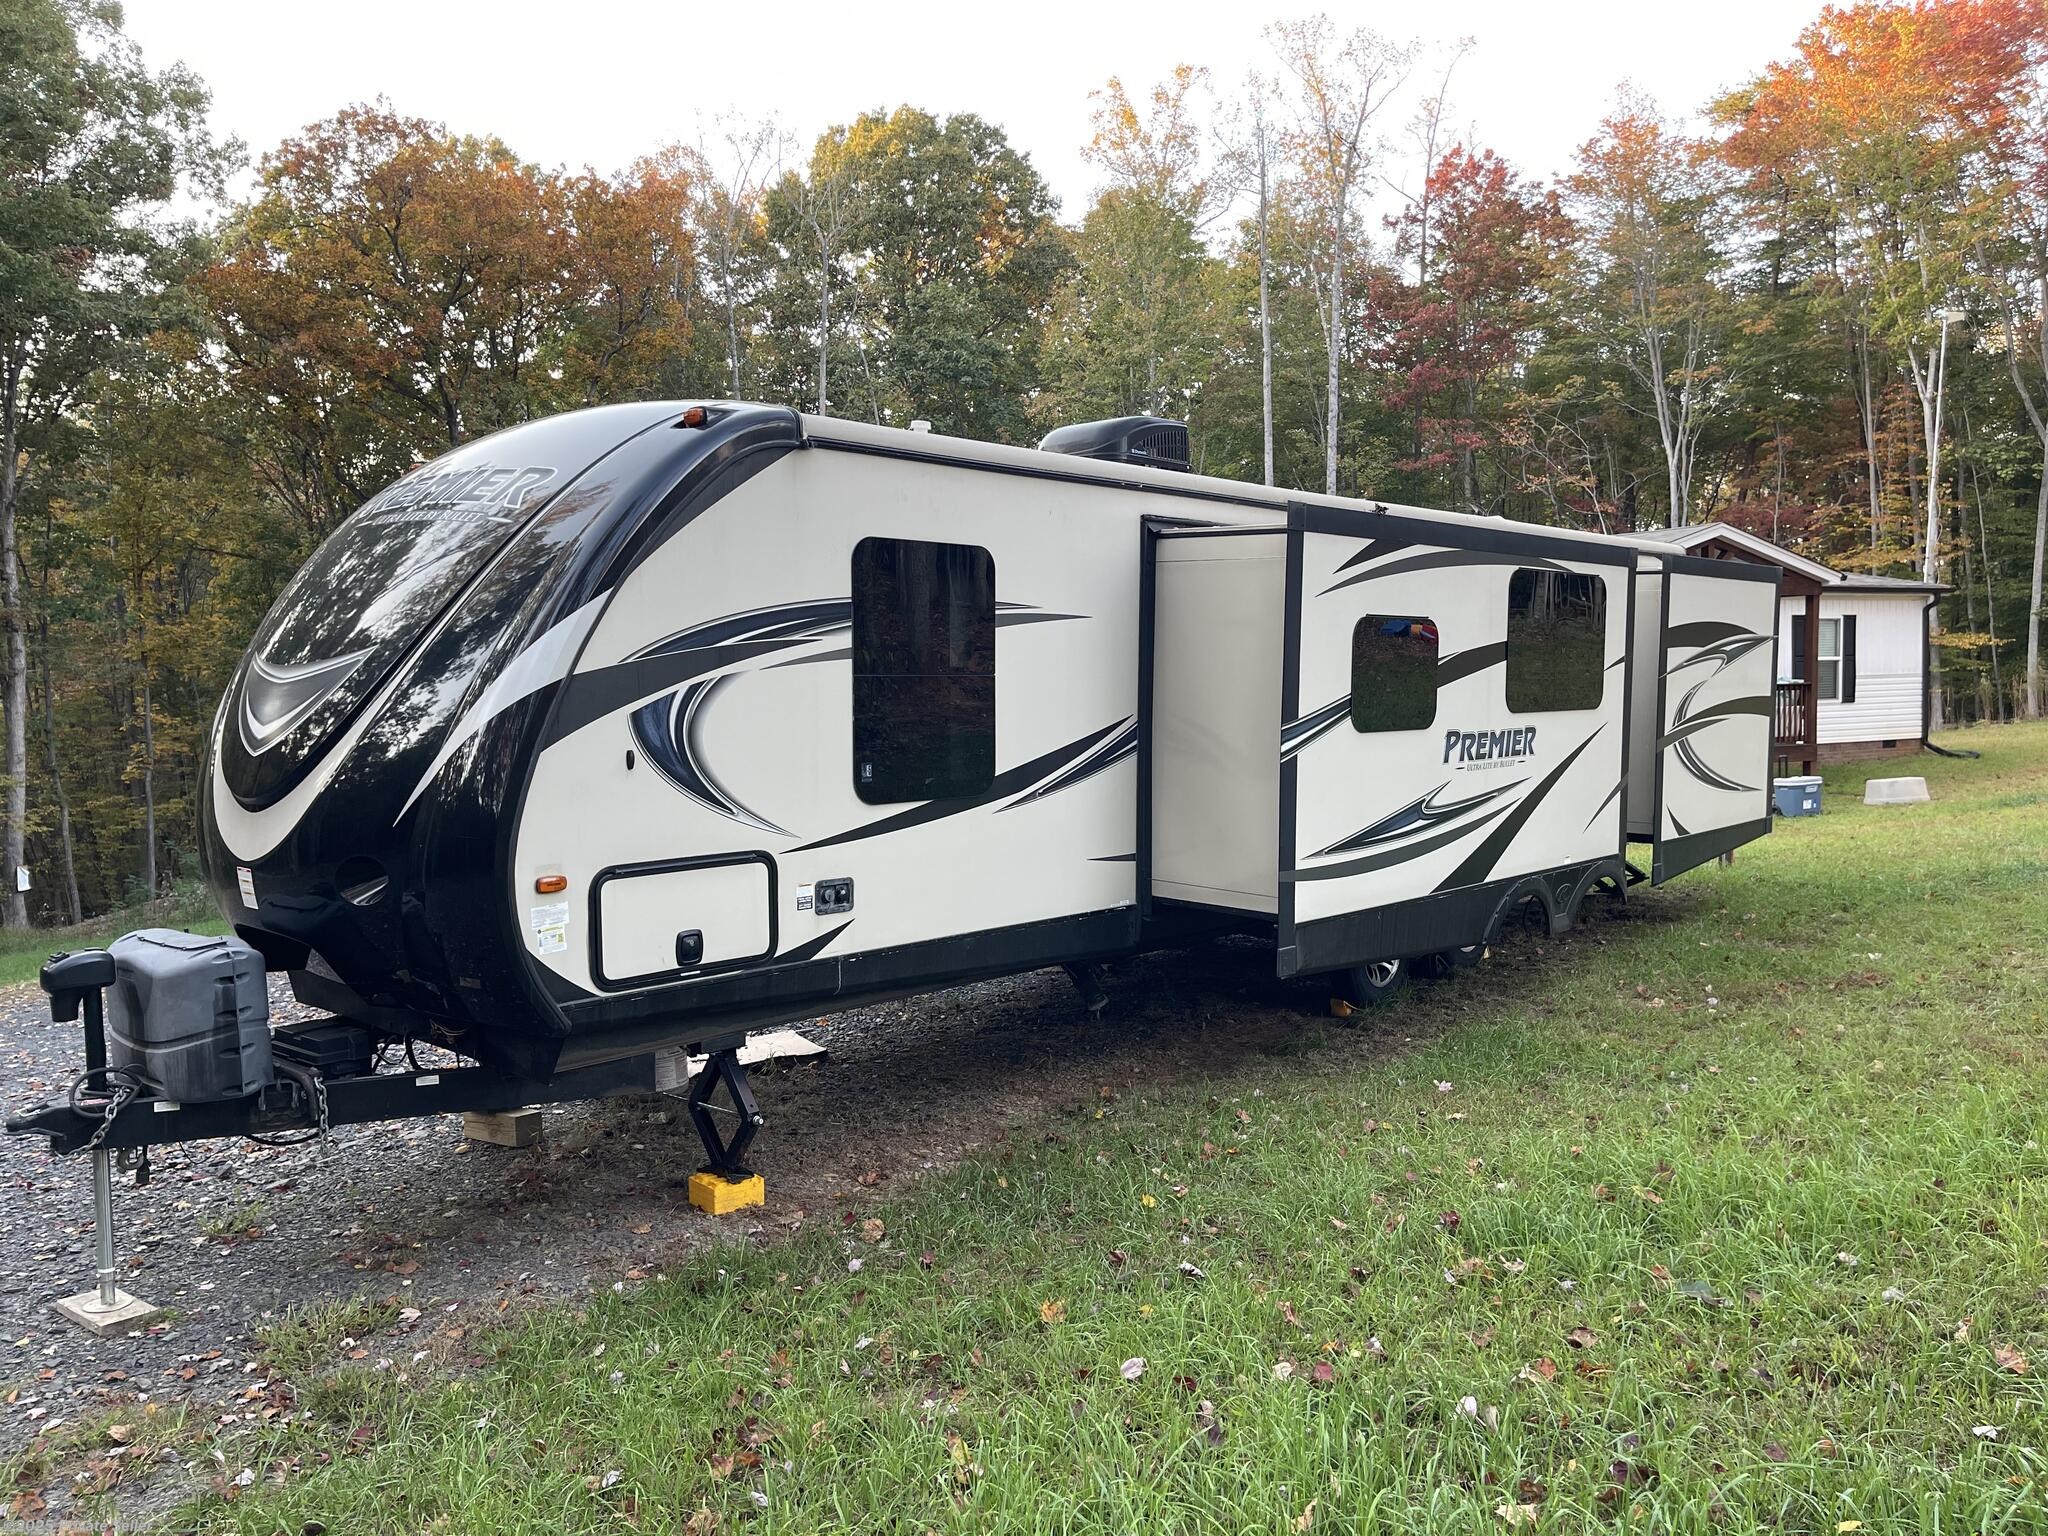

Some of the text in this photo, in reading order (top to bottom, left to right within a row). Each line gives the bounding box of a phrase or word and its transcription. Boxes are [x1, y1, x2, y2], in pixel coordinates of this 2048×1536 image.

[438, 510, 483, 521] BULLET
[1443, 725, 1537, 765] PREMIER
[1466, 763, 1482, 772] ULTRA
[1499, 759, 1516, 768] BULLET
